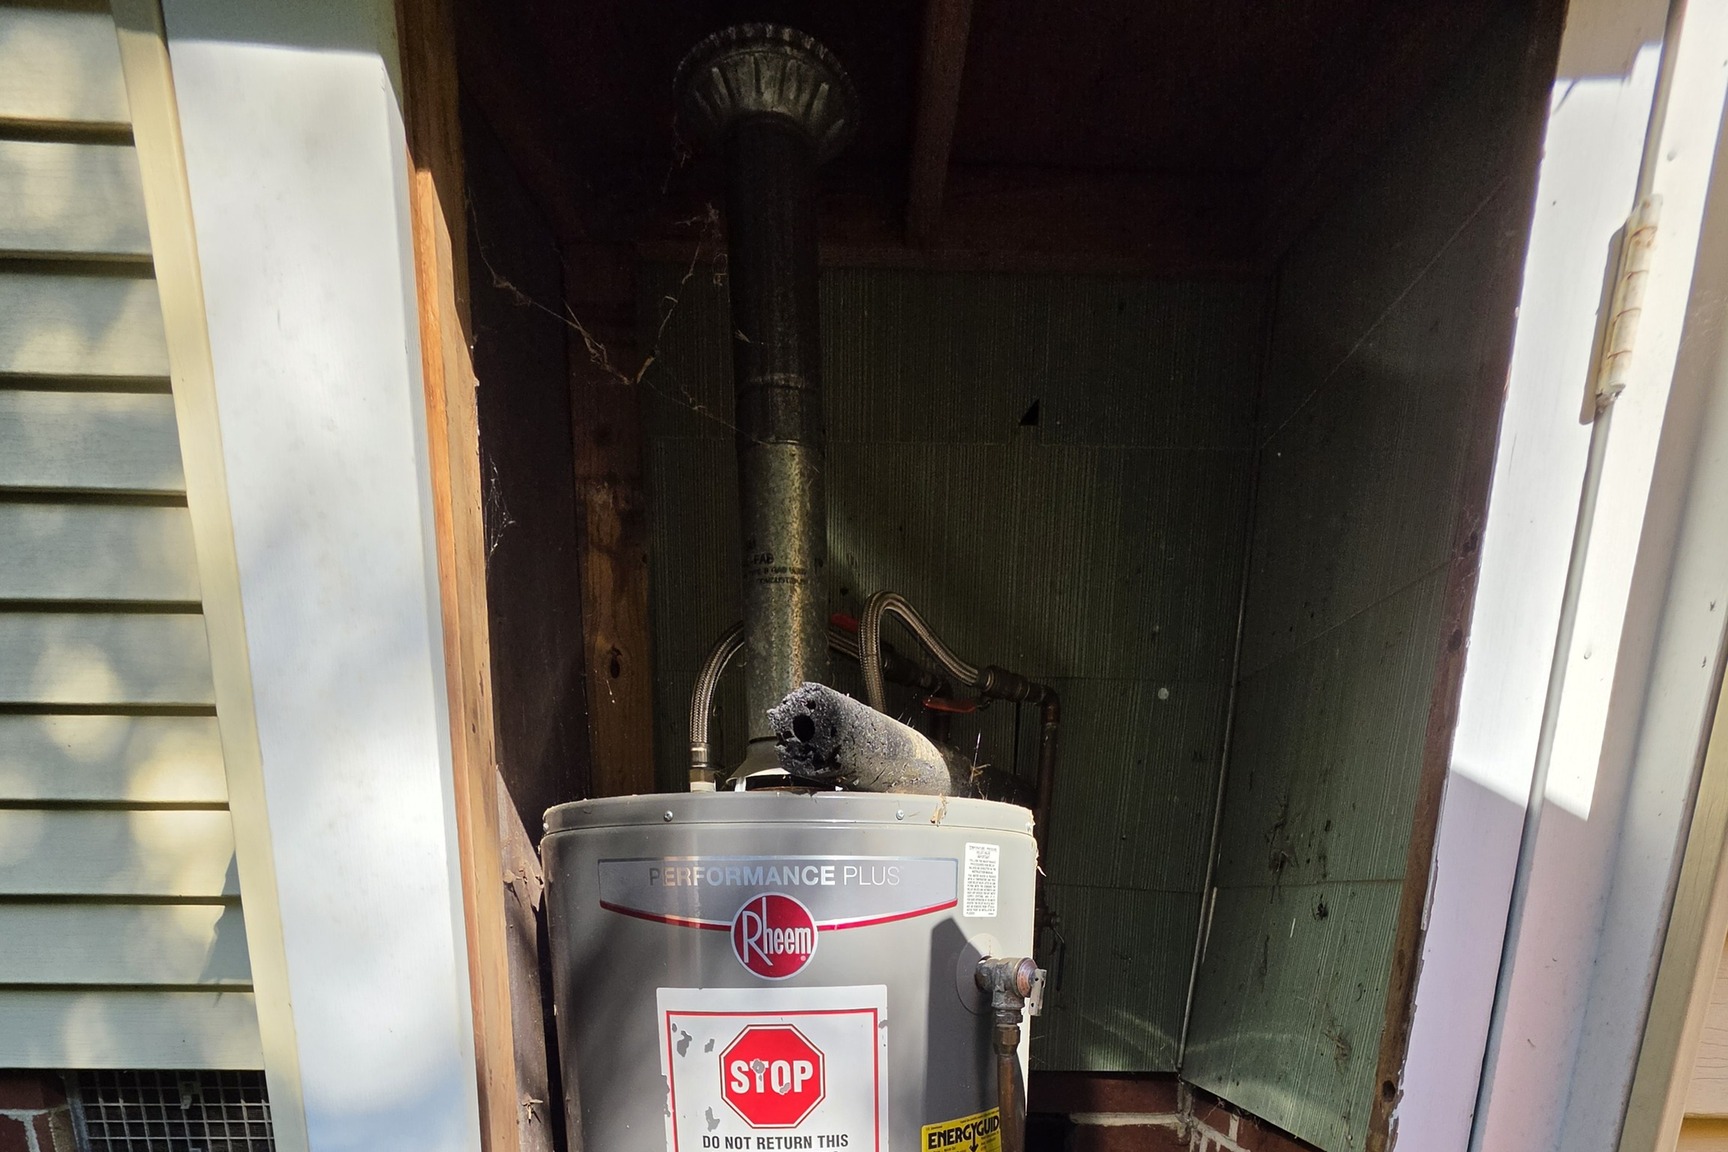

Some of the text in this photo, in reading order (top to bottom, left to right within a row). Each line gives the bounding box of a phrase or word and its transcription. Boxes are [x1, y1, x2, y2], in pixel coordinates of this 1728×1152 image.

[649, 866, 900, 886] PERFORMANCE PLUS
[742, 896, 811, 966] Rheem
[731, 1060, 813, 1093] STOP
[702, 1134, 849, 1150] DO NOT RETURN THIS
[928, 1116, 999, 1150] ENERGYGUID
